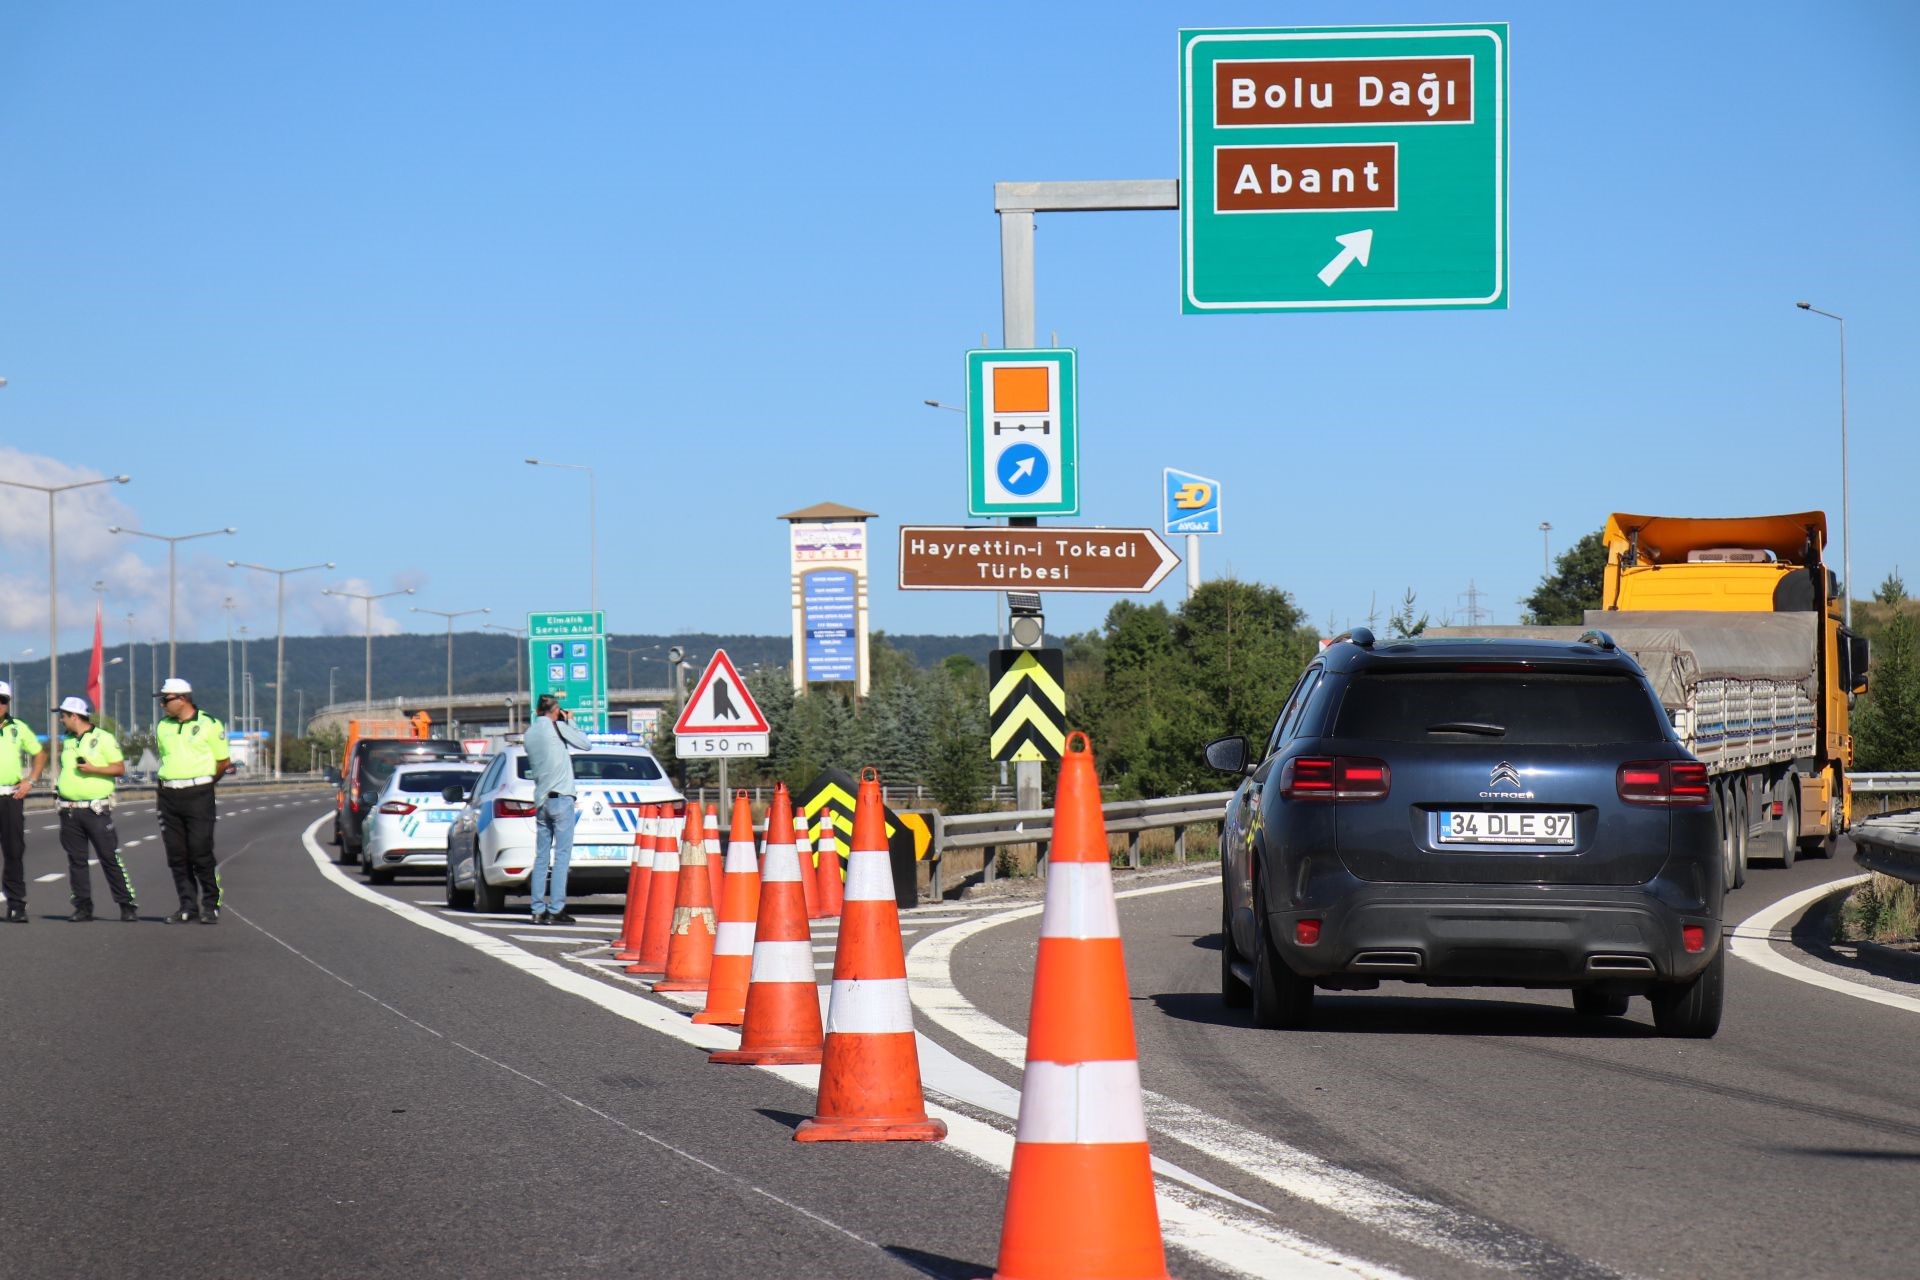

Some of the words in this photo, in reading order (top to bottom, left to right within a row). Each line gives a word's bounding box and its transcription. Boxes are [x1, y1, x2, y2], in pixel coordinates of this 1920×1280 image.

[1231, 76, 1333, 109] Bolu
[1358, 72, 1455, 117] Dağı
[1233, 161, 1379, 195] Abant
[1177, 521, 1210, 531] AYGAZ
[910, 538, 1042, 560] Hayrettin-i
[1055, 540, 1137, 558] Tokadi
[976, 562, 1070, 580] Türbesi
[535, 625, 569, 635] Servis
[690, 738, 729, 752] 150
[737, 742, 753, 752] m
[1452, 814, 1478, 835] 34
[1487, 814, 1536, 836] DLE
[1544, 815, 1570, 837] 97
